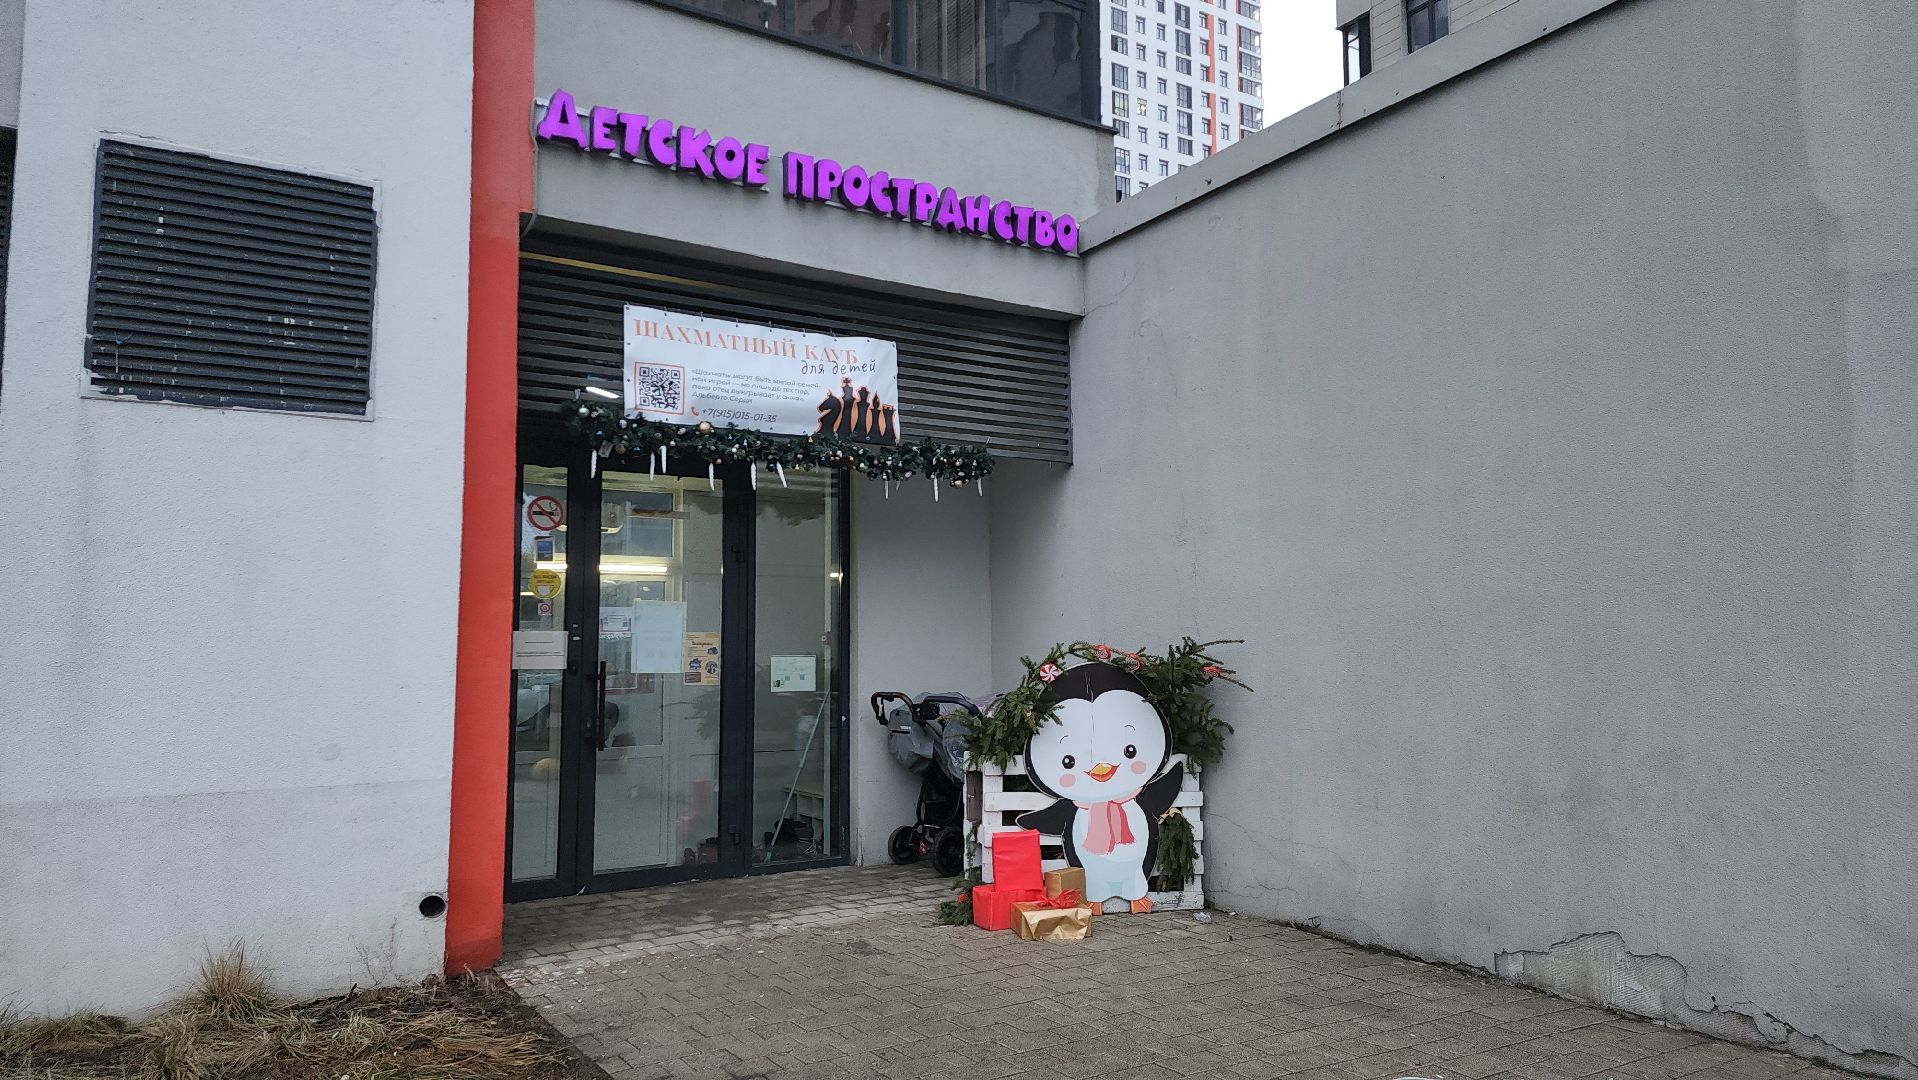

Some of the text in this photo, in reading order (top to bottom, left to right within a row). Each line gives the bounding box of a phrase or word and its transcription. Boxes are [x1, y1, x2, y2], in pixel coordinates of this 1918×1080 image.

[537, 88, 1079, 254] ДЕТСКОЕ ПРОСТРАНСТВО
[635, 319, 858, 364] ШАХМАТНЫЙ КЛУБ
[801, 359, 877, 374] для детей
